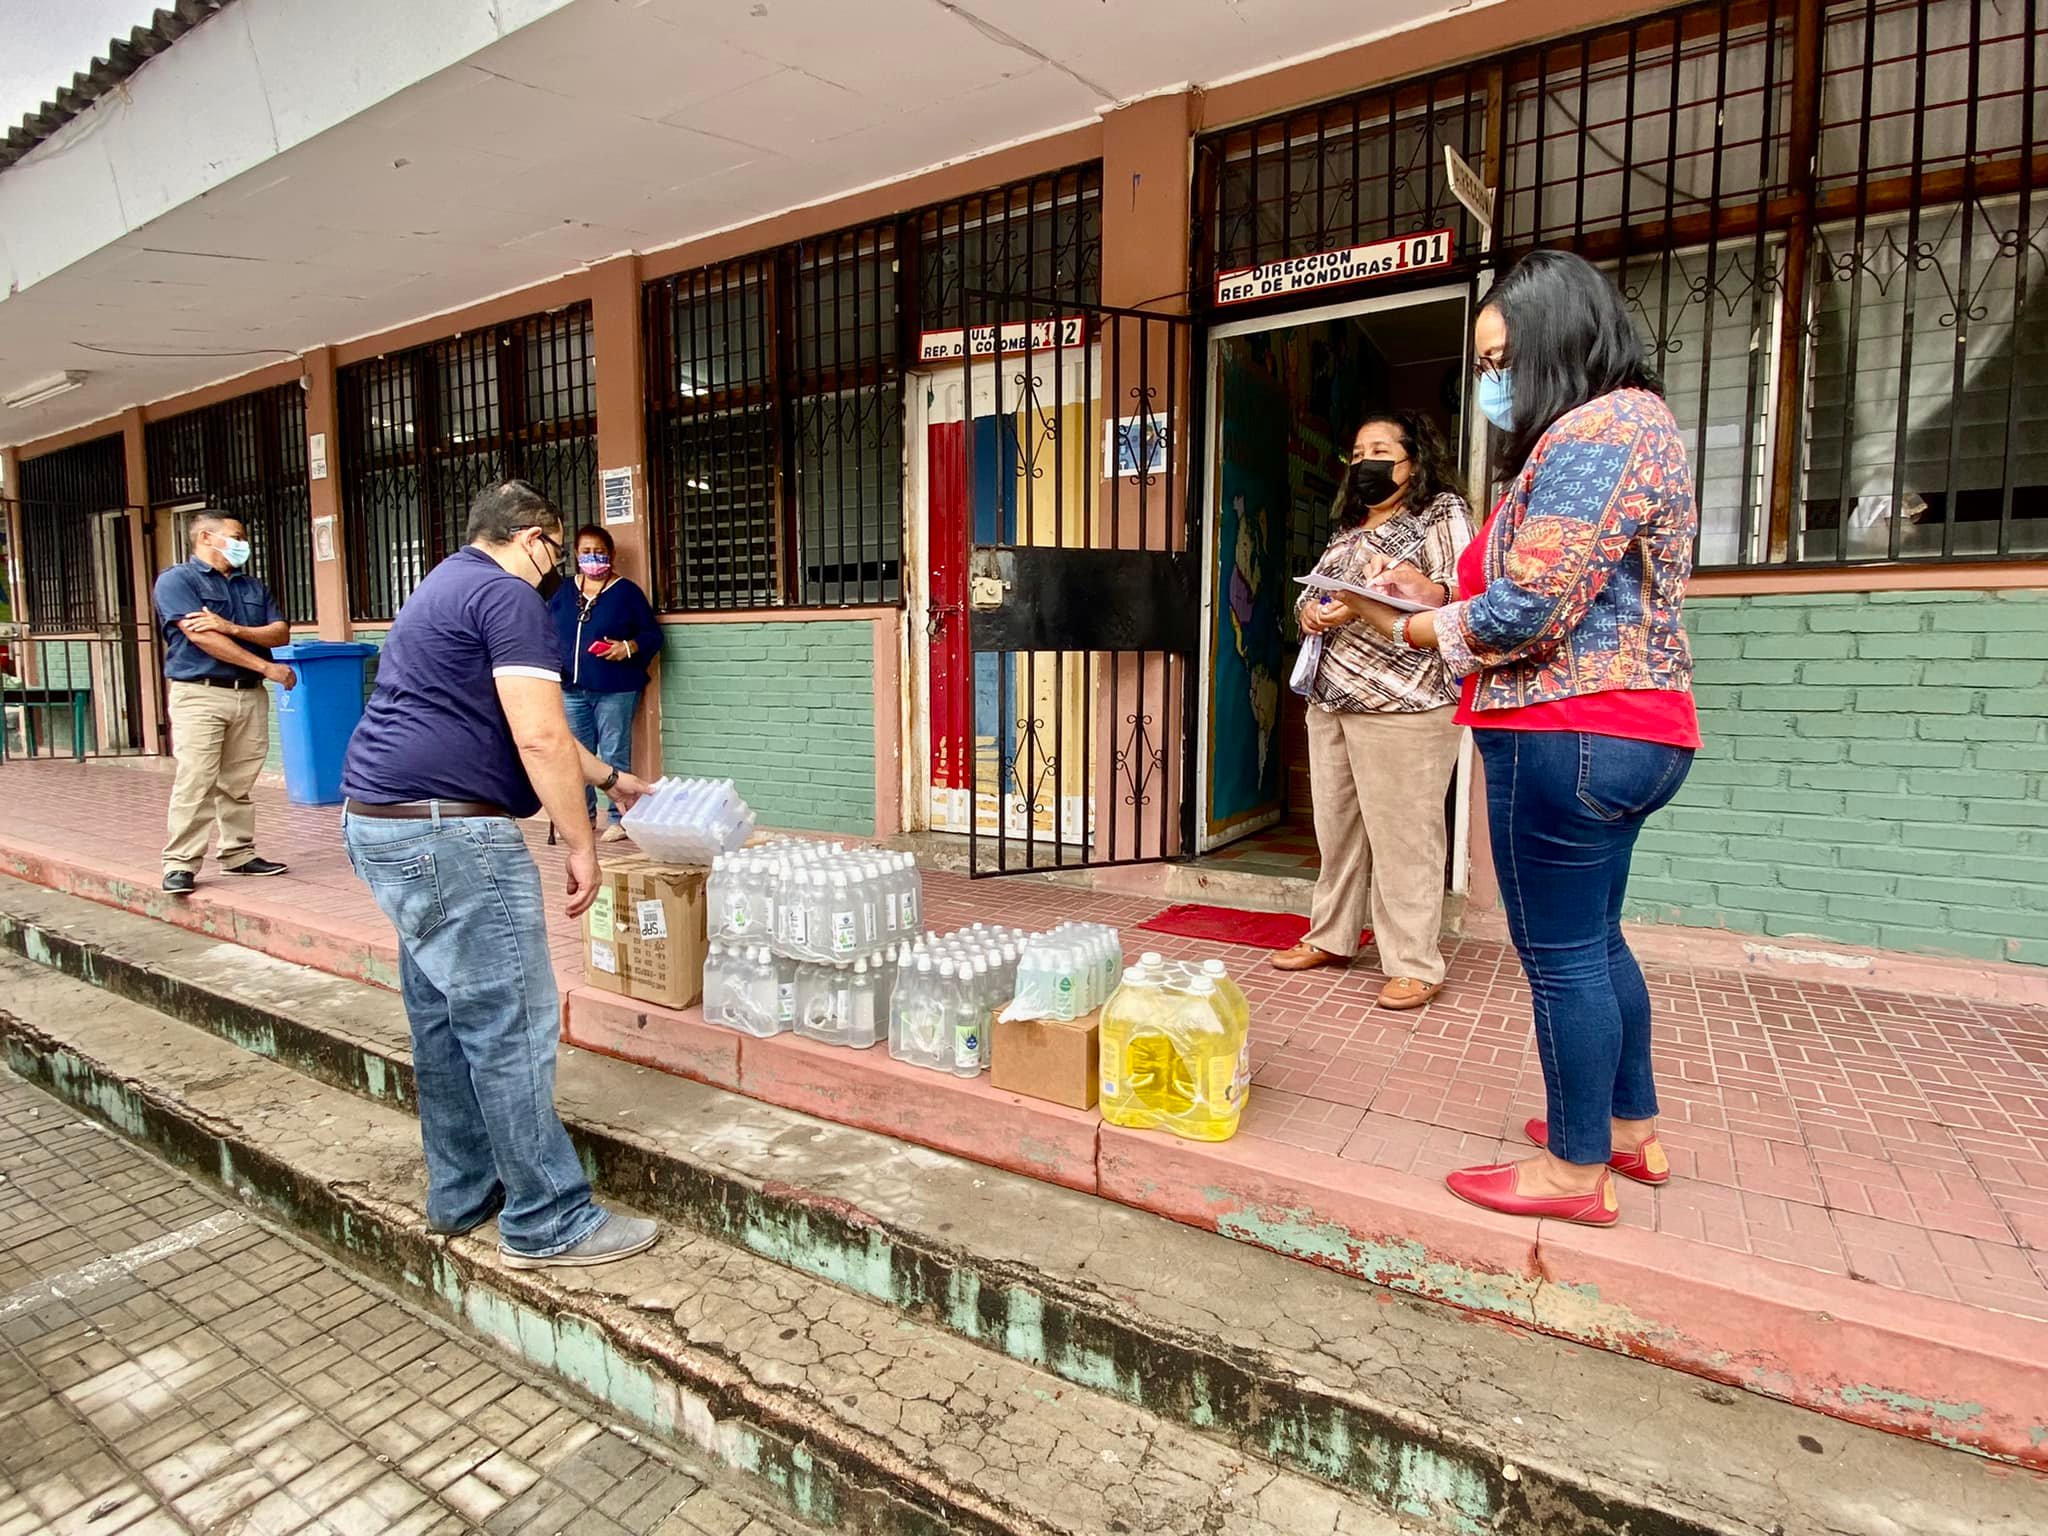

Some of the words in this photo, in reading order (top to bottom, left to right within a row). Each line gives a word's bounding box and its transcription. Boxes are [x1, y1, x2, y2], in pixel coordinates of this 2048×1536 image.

[1252, 249, 1352, 281] DIRECCION
[1396, 235, 1445, 269] 101
[1220, 285, 1254, 302] REP.
[1261, 279, 1283, 294] DE
[1291, 257, 1393, 289] HONDURAS
[924, 346, 948, 358] REP.
[954, 343, 969, 355] D
[976, 336, 1040, 353] COOMBA
[966, 328, 997, 341] ULA
[1042, 321, 1076, 347] 12
